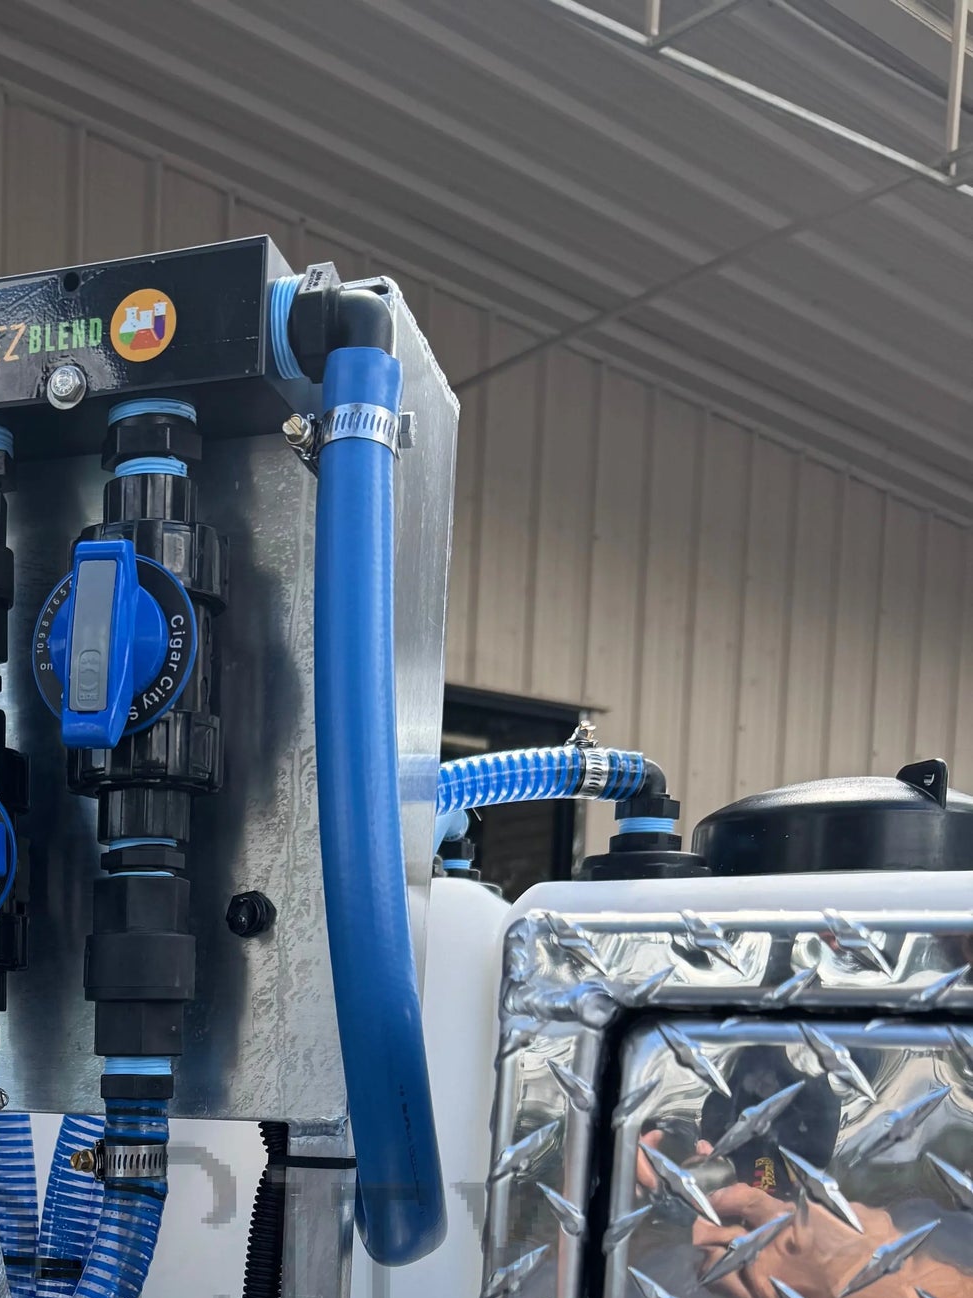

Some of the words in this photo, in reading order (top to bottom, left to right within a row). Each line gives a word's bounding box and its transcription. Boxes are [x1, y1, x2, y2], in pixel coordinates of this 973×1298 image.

[28, 317, 103, 354] BLEND
[169, 613, 186, 672] Cigar
[142, 675, 174, 711] City
